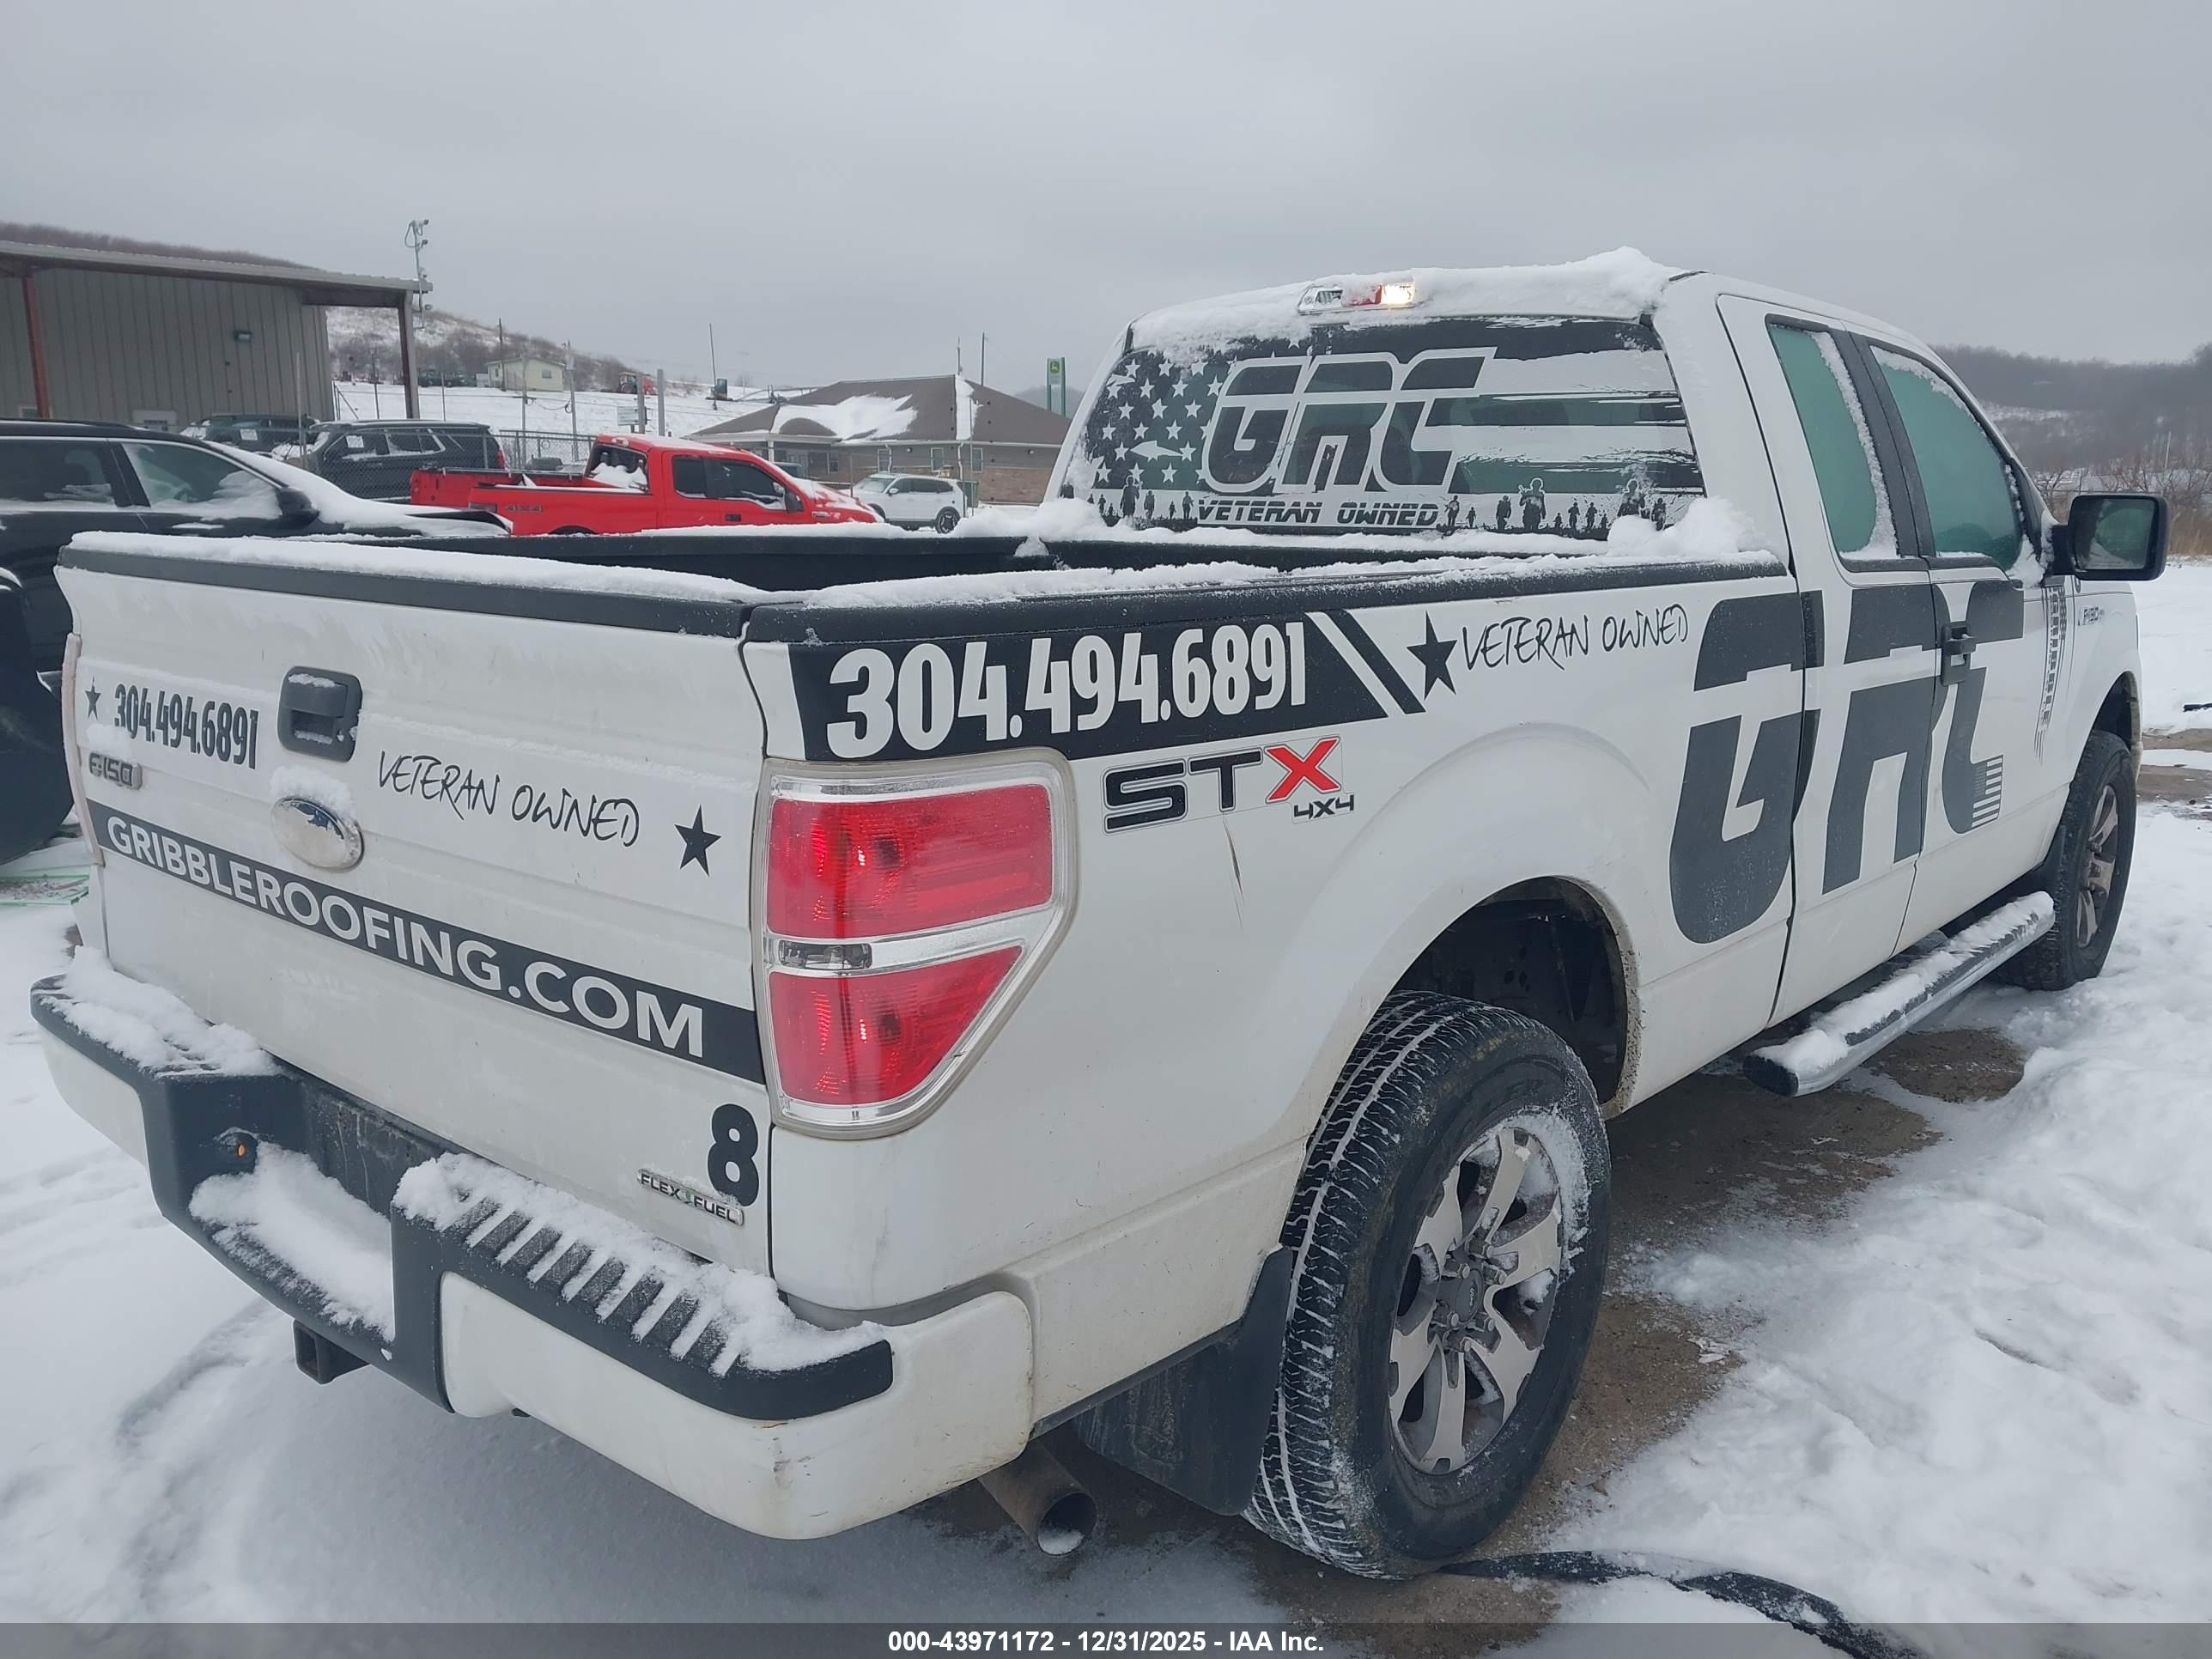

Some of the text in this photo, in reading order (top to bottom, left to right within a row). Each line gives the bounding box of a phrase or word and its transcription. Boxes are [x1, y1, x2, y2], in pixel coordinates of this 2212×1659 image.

[1204, 347, 1498, 494] GRC
[1198, 500, 1439, 526] VETERAN OWNED
[1462, 604, 1688, 671] VETERAN OWNED
[114, 684, 259, 769] 304.494.6891
[827, 622, 1306, 758] 304.494.6891
[377, 750, 640, 847] VETERAN OWNED
[1103, 736, 1343, 834] STX
[106, 817, 704, 1058] GRIBBLEROOFING.COM
[641, 1173, 737, 1224] FLEX FUEL
[707, 1103, 759, 1207] 8
